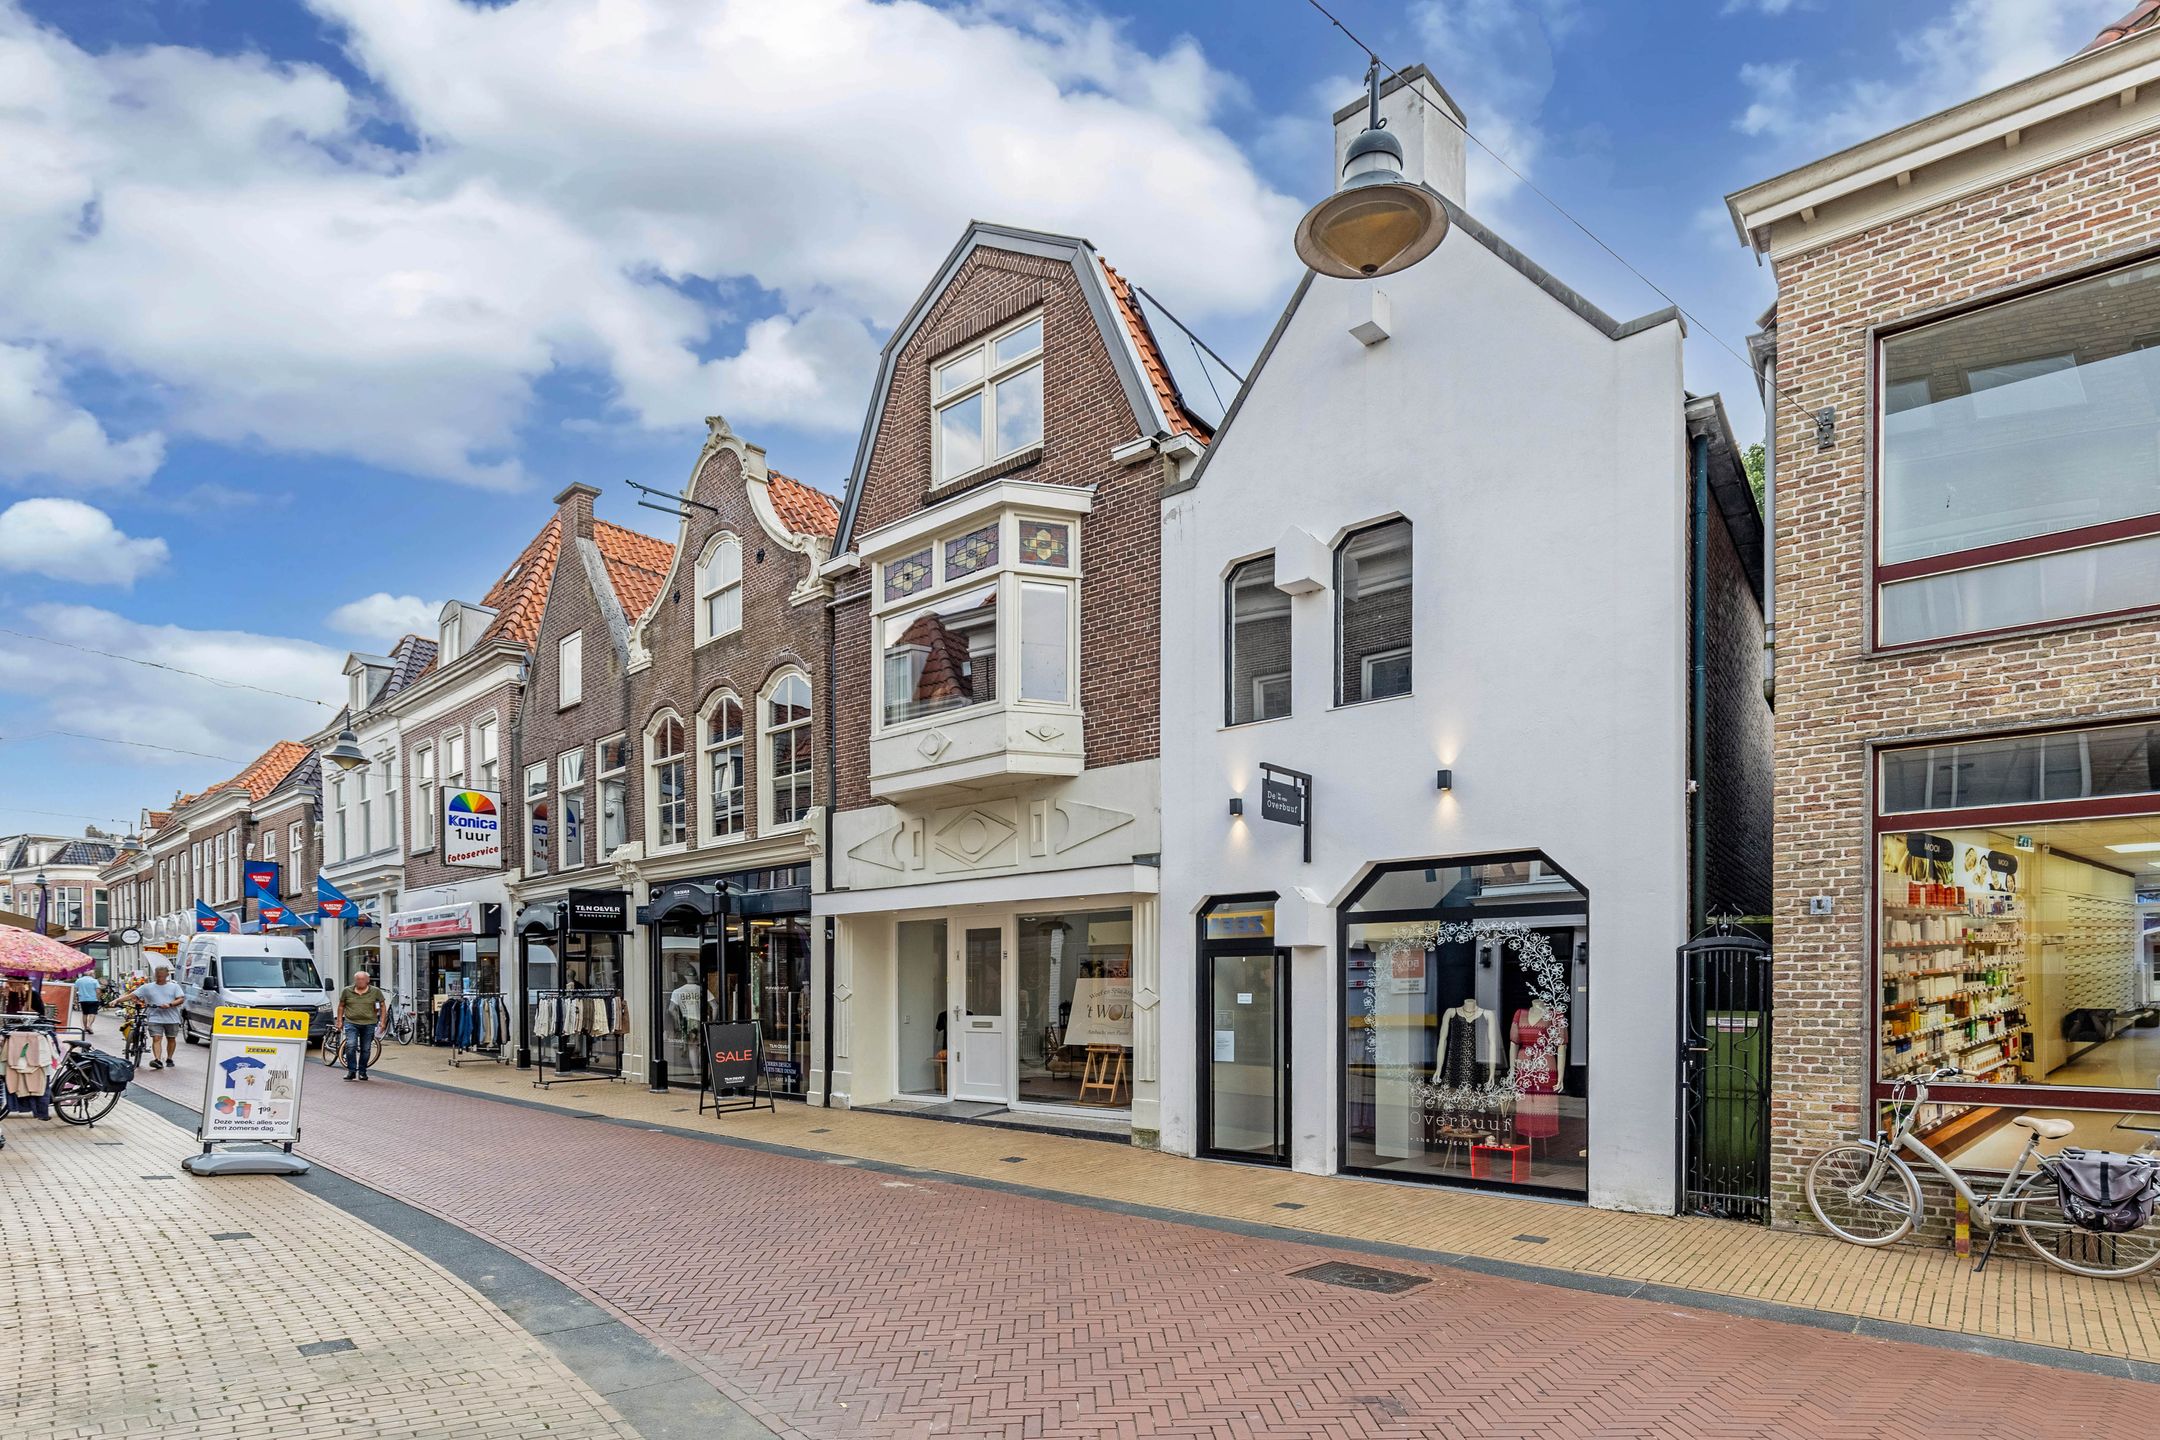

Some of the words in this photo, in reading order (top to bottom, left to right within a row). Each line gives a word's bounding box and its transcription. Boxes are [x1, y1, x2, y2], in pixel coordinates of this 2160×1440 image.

[1267, 790, 1276, 800] De
[448, 814, 498, 831] Konica
[465, 832, 491, 842] uur
[1924, 842, 1940, 852] MOOI
[447, 845, 499, 863] fotoservice
[575, 904, 593, 912] TEN
[593, 905, 621, 913] OEVER
[221, 1014, 302, 1031] ZEEMAN
[247, 1047, 275, 1055] ZEEMAN
[715, 1049, 753, 1063] SALE
[1409, 1111, 1512, 1132] Overbuuf
